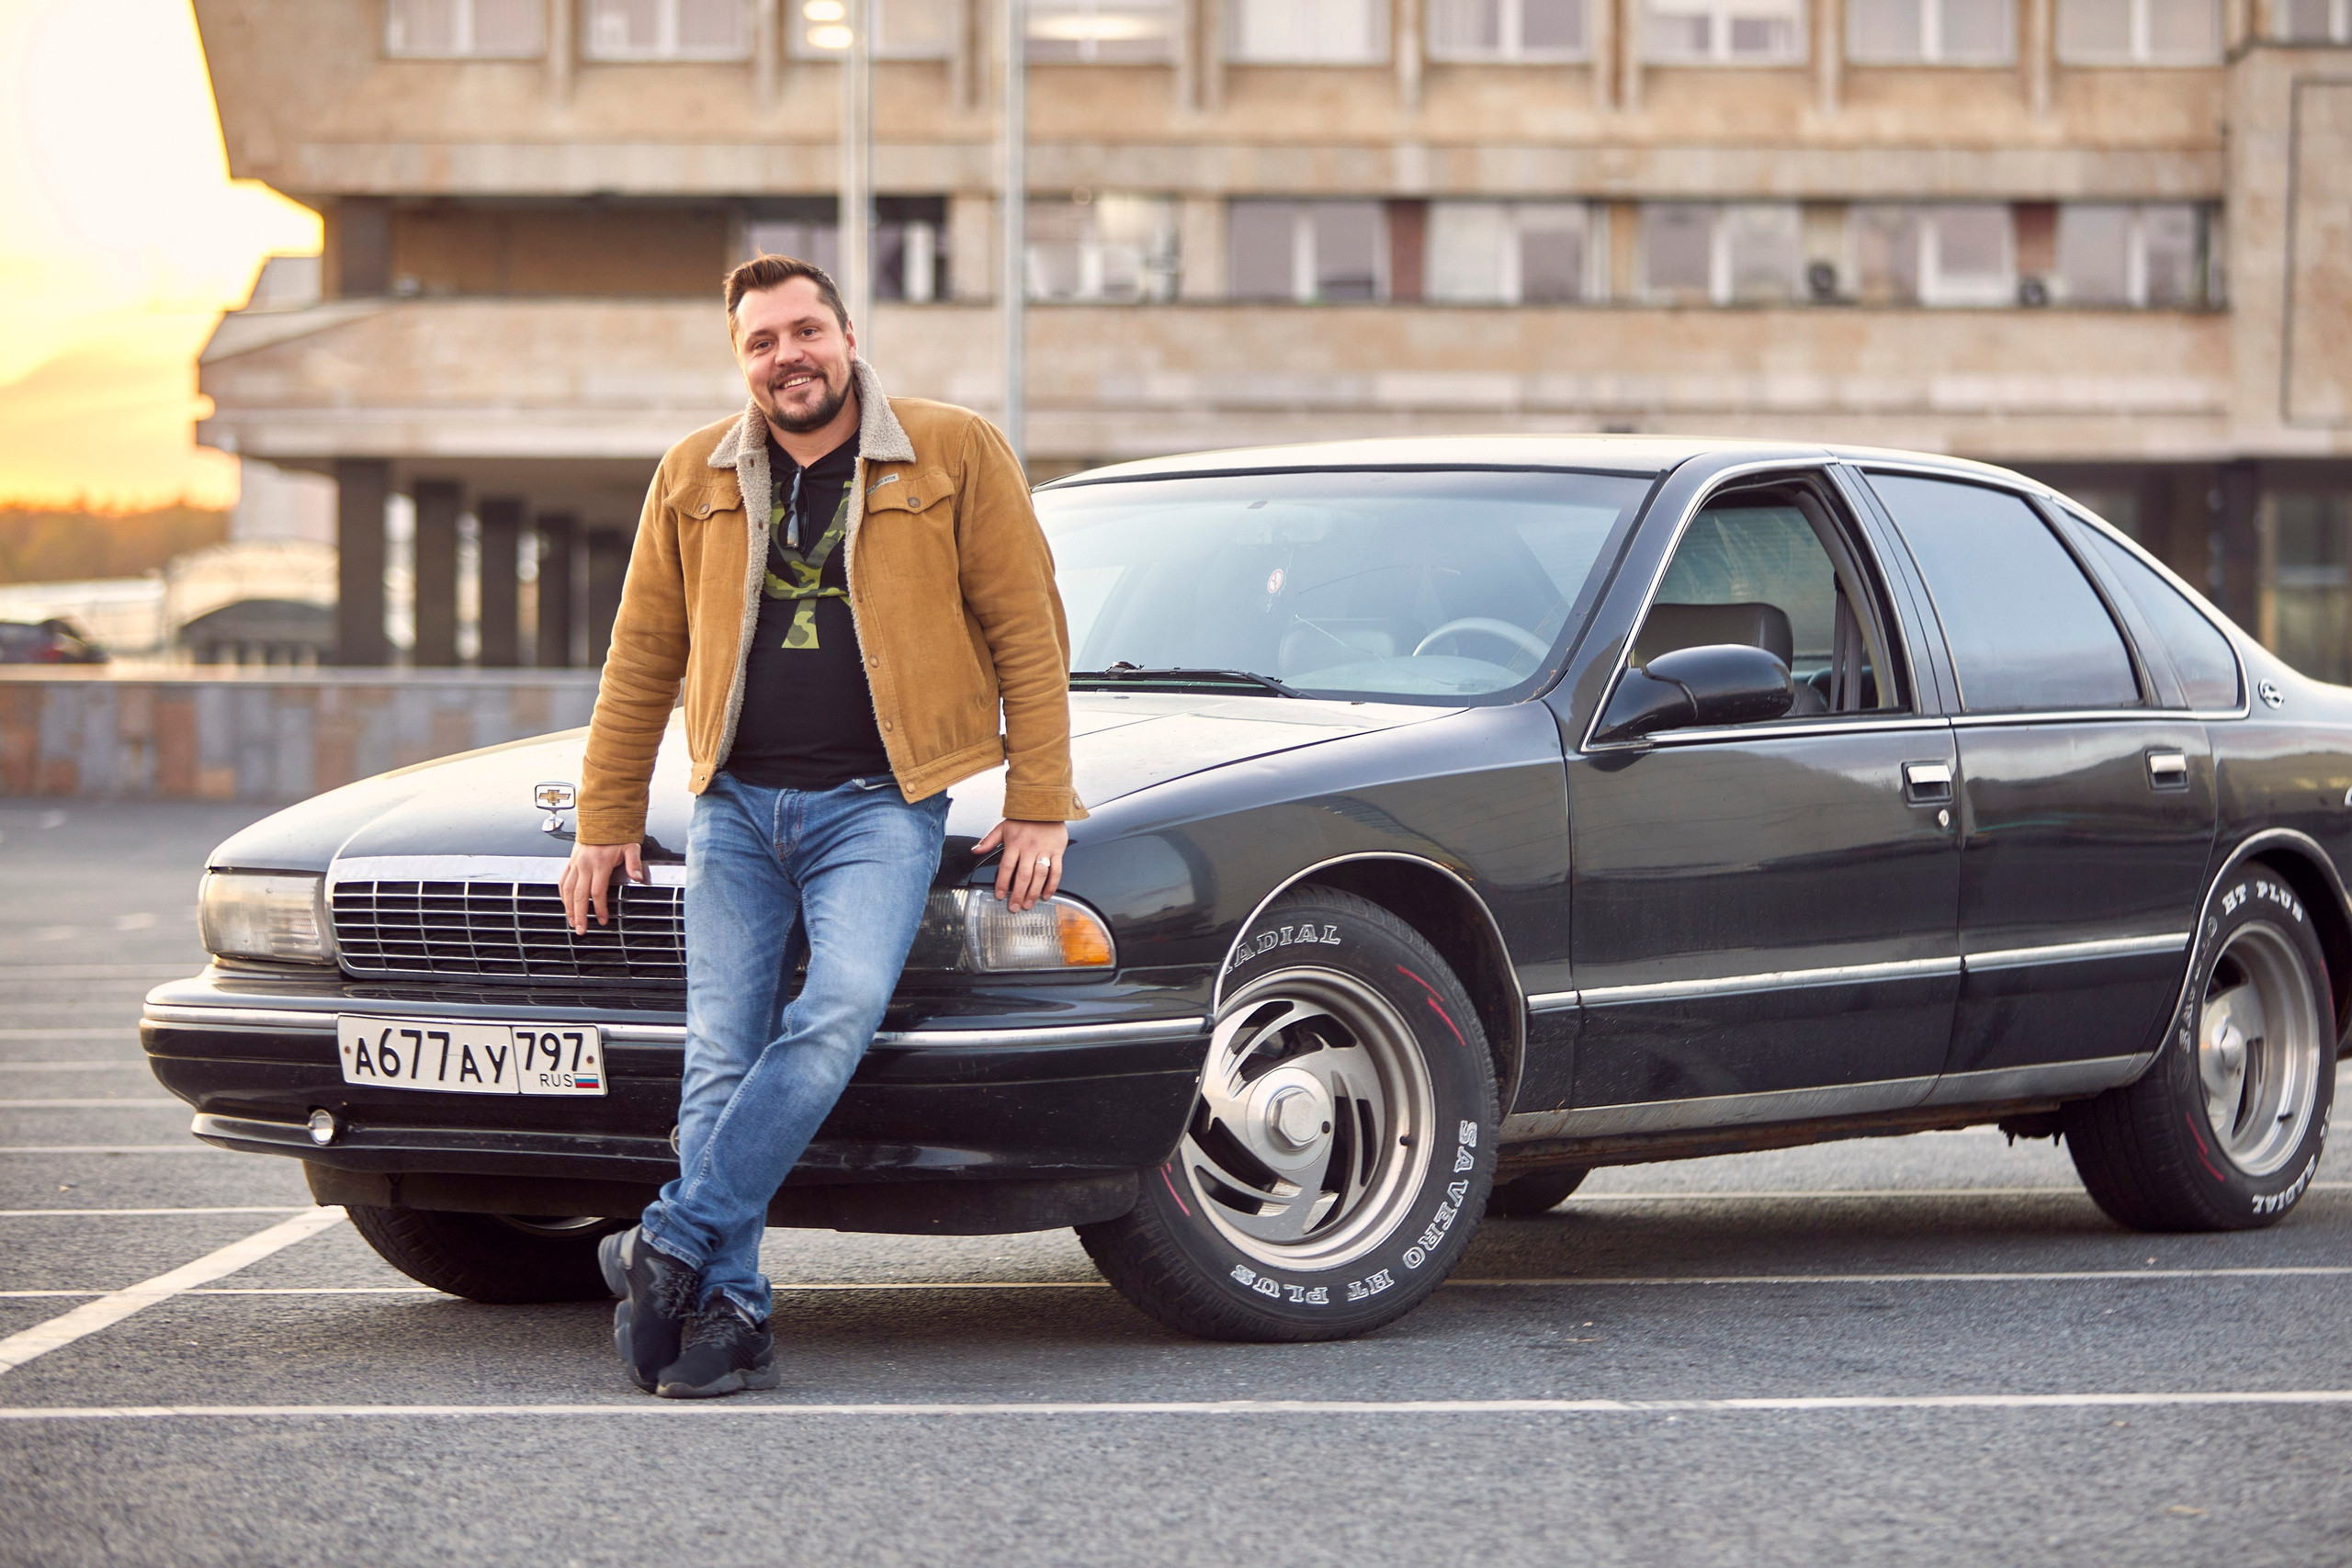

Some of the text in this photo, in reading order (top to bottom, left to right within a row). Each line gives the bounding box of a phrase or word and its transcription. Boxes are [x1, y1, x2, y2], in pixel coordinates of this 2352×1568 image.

[1225, 923, 1341, 975] ADIAL
[516, 1032, 583, 1073] 797
[540, 1073, 573, 1088] RUS
[1230, 1120, 1478, 1304] SAVERO HT PLUS
